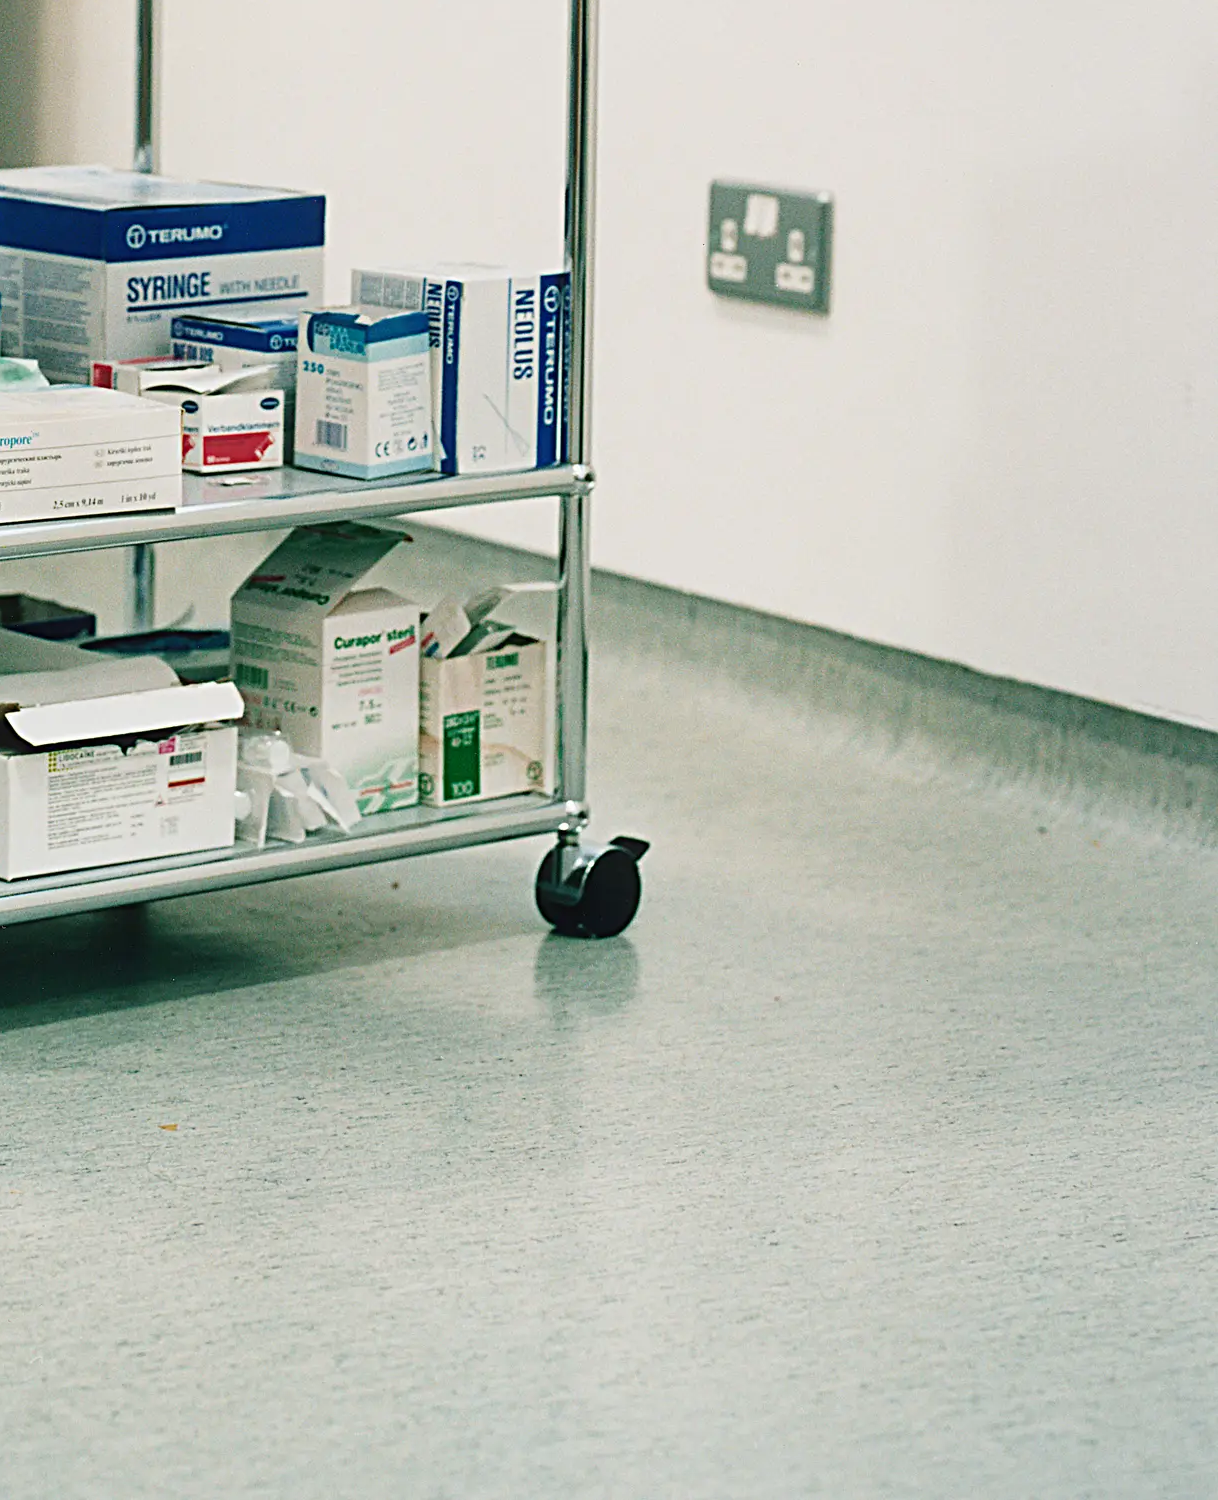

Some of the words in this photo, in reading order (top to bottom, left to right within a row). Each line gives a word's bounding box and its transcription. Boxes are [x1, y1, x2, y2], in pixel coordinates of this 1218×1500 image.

[148, 224, 223, 243] TERUMO
[127, 272, 211, 303] SYRINGE
[219, 280, 251, 295] WITH
[254, 274, 300, 292] NEEDLE
[446, 302, 456, 365] TERUMO
[513, 289, 535, 381] NEOLUS
[302, 360, 325, 375] 250
[544, 315, 557, 426] TERUMO
[334, 633, 382, 650] Curapor
